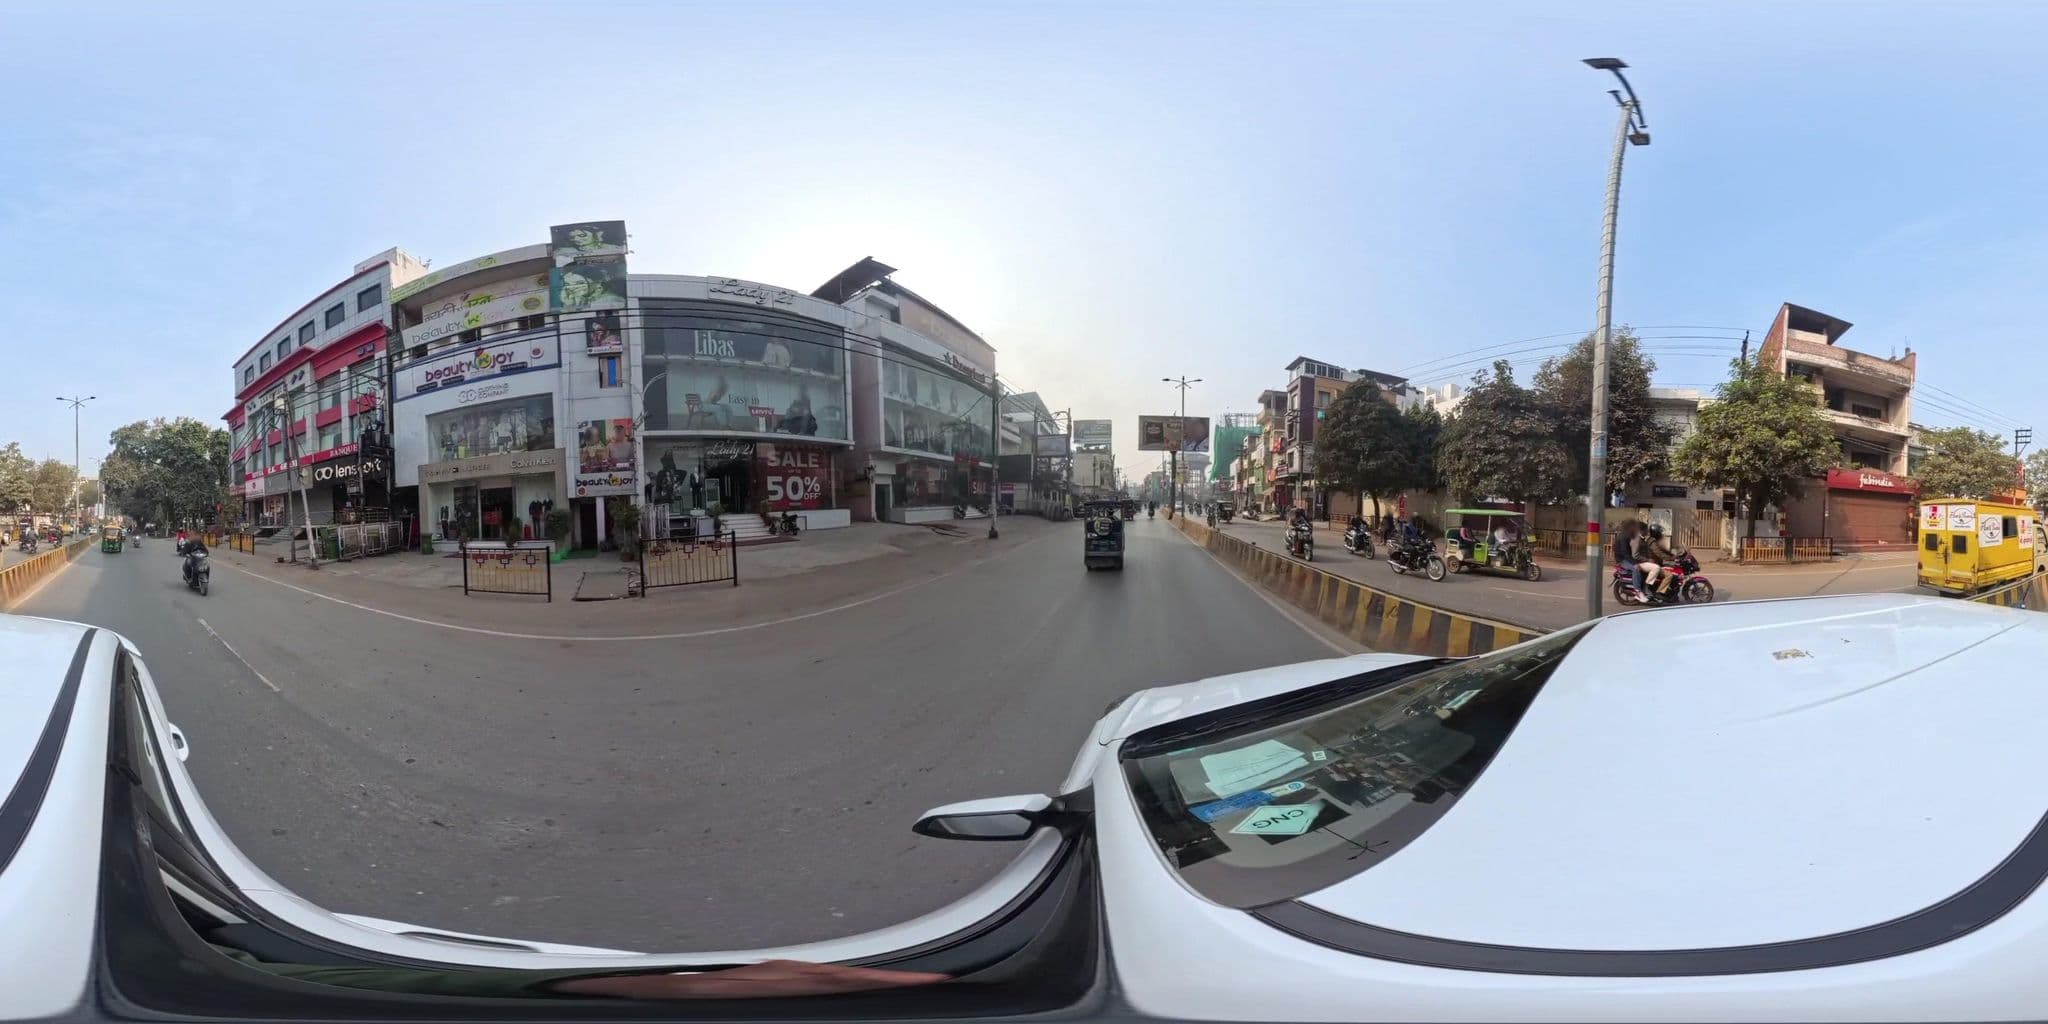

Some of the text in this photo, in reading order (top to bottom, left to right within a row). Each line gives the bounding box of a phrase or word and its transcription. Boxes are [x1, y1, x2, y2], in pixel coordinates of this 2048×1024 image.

[709, 279, 769, 305] Lady
[412, 321, 461, 345] beauty
[694, 330, 736, 358] Libas
[425, 359, 473, 382] beauty
[706, 440, 739, 459] Lady
[742, 443, 755, 455] 21
[767, 451, 820, 468] SALE
[576, 477, 608, 487] beauty
[767, 475, 821, 501] 50%
[1859, 473, 1895, 488] fabindia
[1252, 808, 1305, 829] CNG
